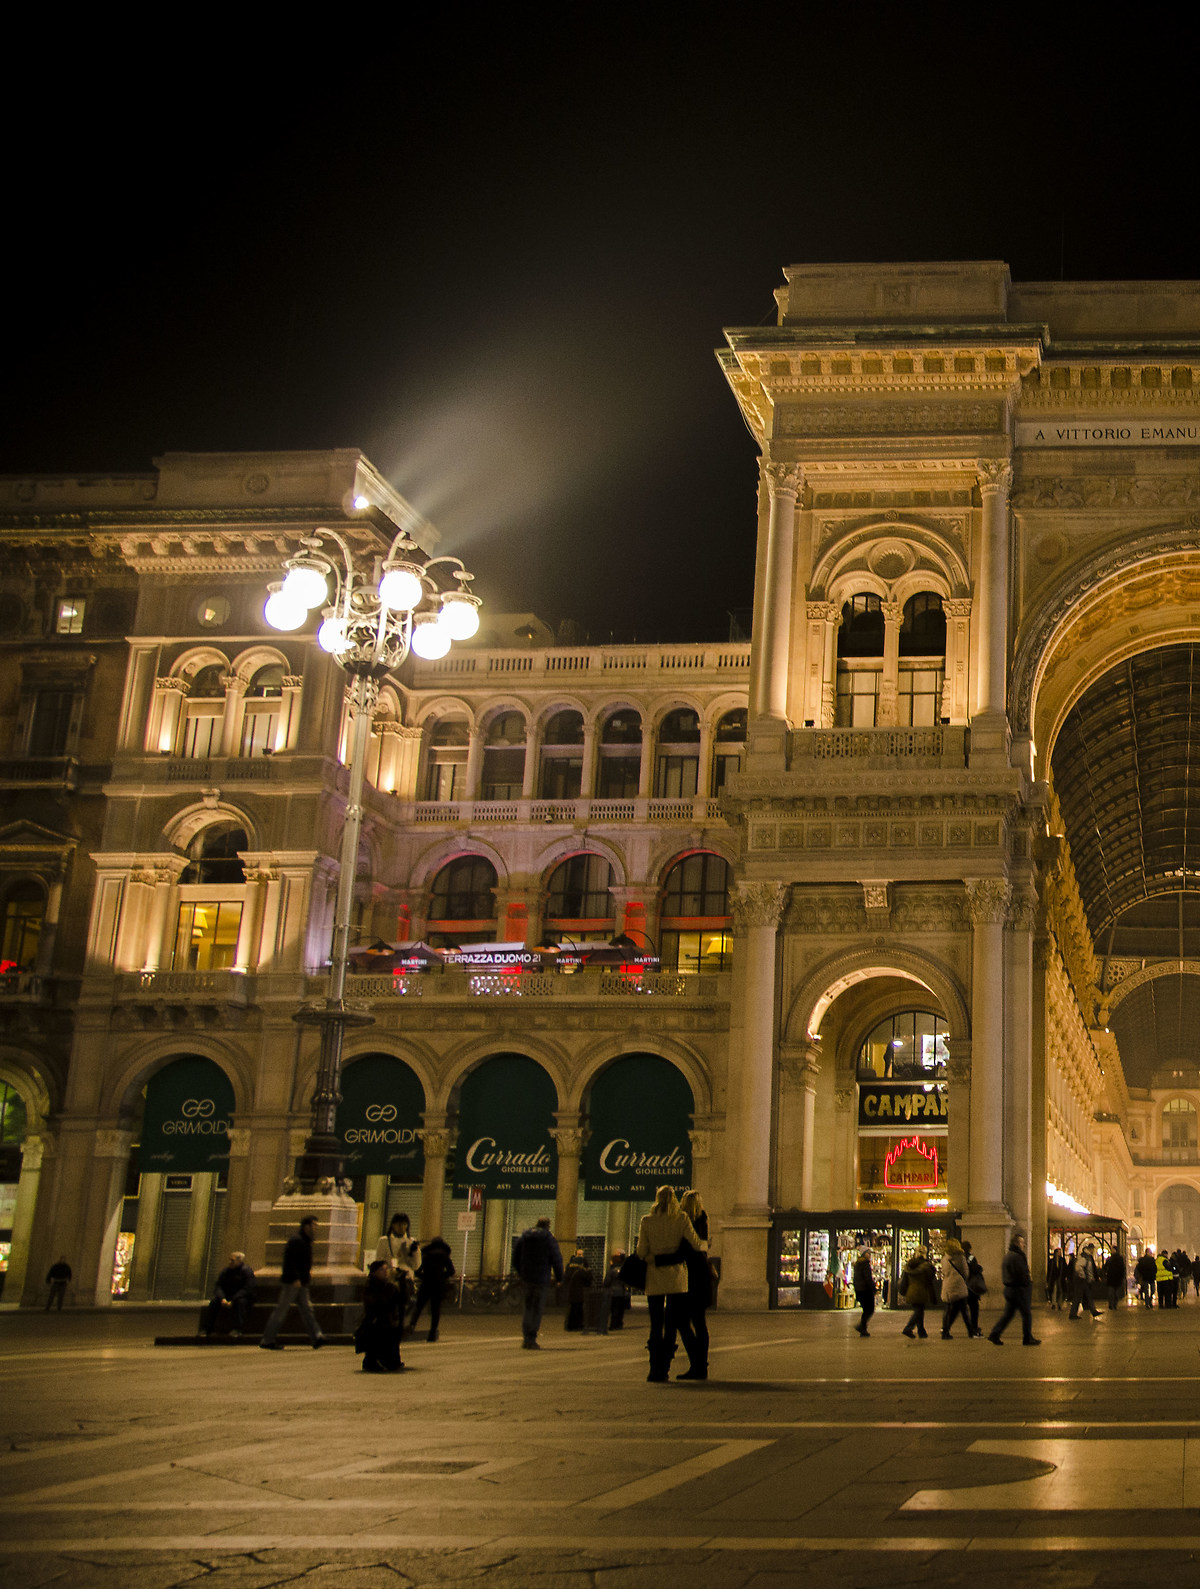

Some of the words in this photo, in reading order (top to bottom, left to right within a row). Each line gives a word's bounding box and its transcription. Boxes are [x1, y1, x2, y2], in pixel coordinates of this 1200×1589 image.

[1035, 429, 1046, 440] A
[1056, 428, 1131, 440] VITTORIO
[443, 953, 493, 964] TERRAZZA
[494, 953, 532, 963] DUOMO
[532, 954, 541, 963] 21
[863, 1093, 948, 1120] CAMPAR
[344, 1128, 416, 1144] GRIMOLDI
[466, 1137, 551, 1173] Currado
[600, 1138, 685, 1174] Currado
[890, 1174, 934, 1183] CAMPARI
